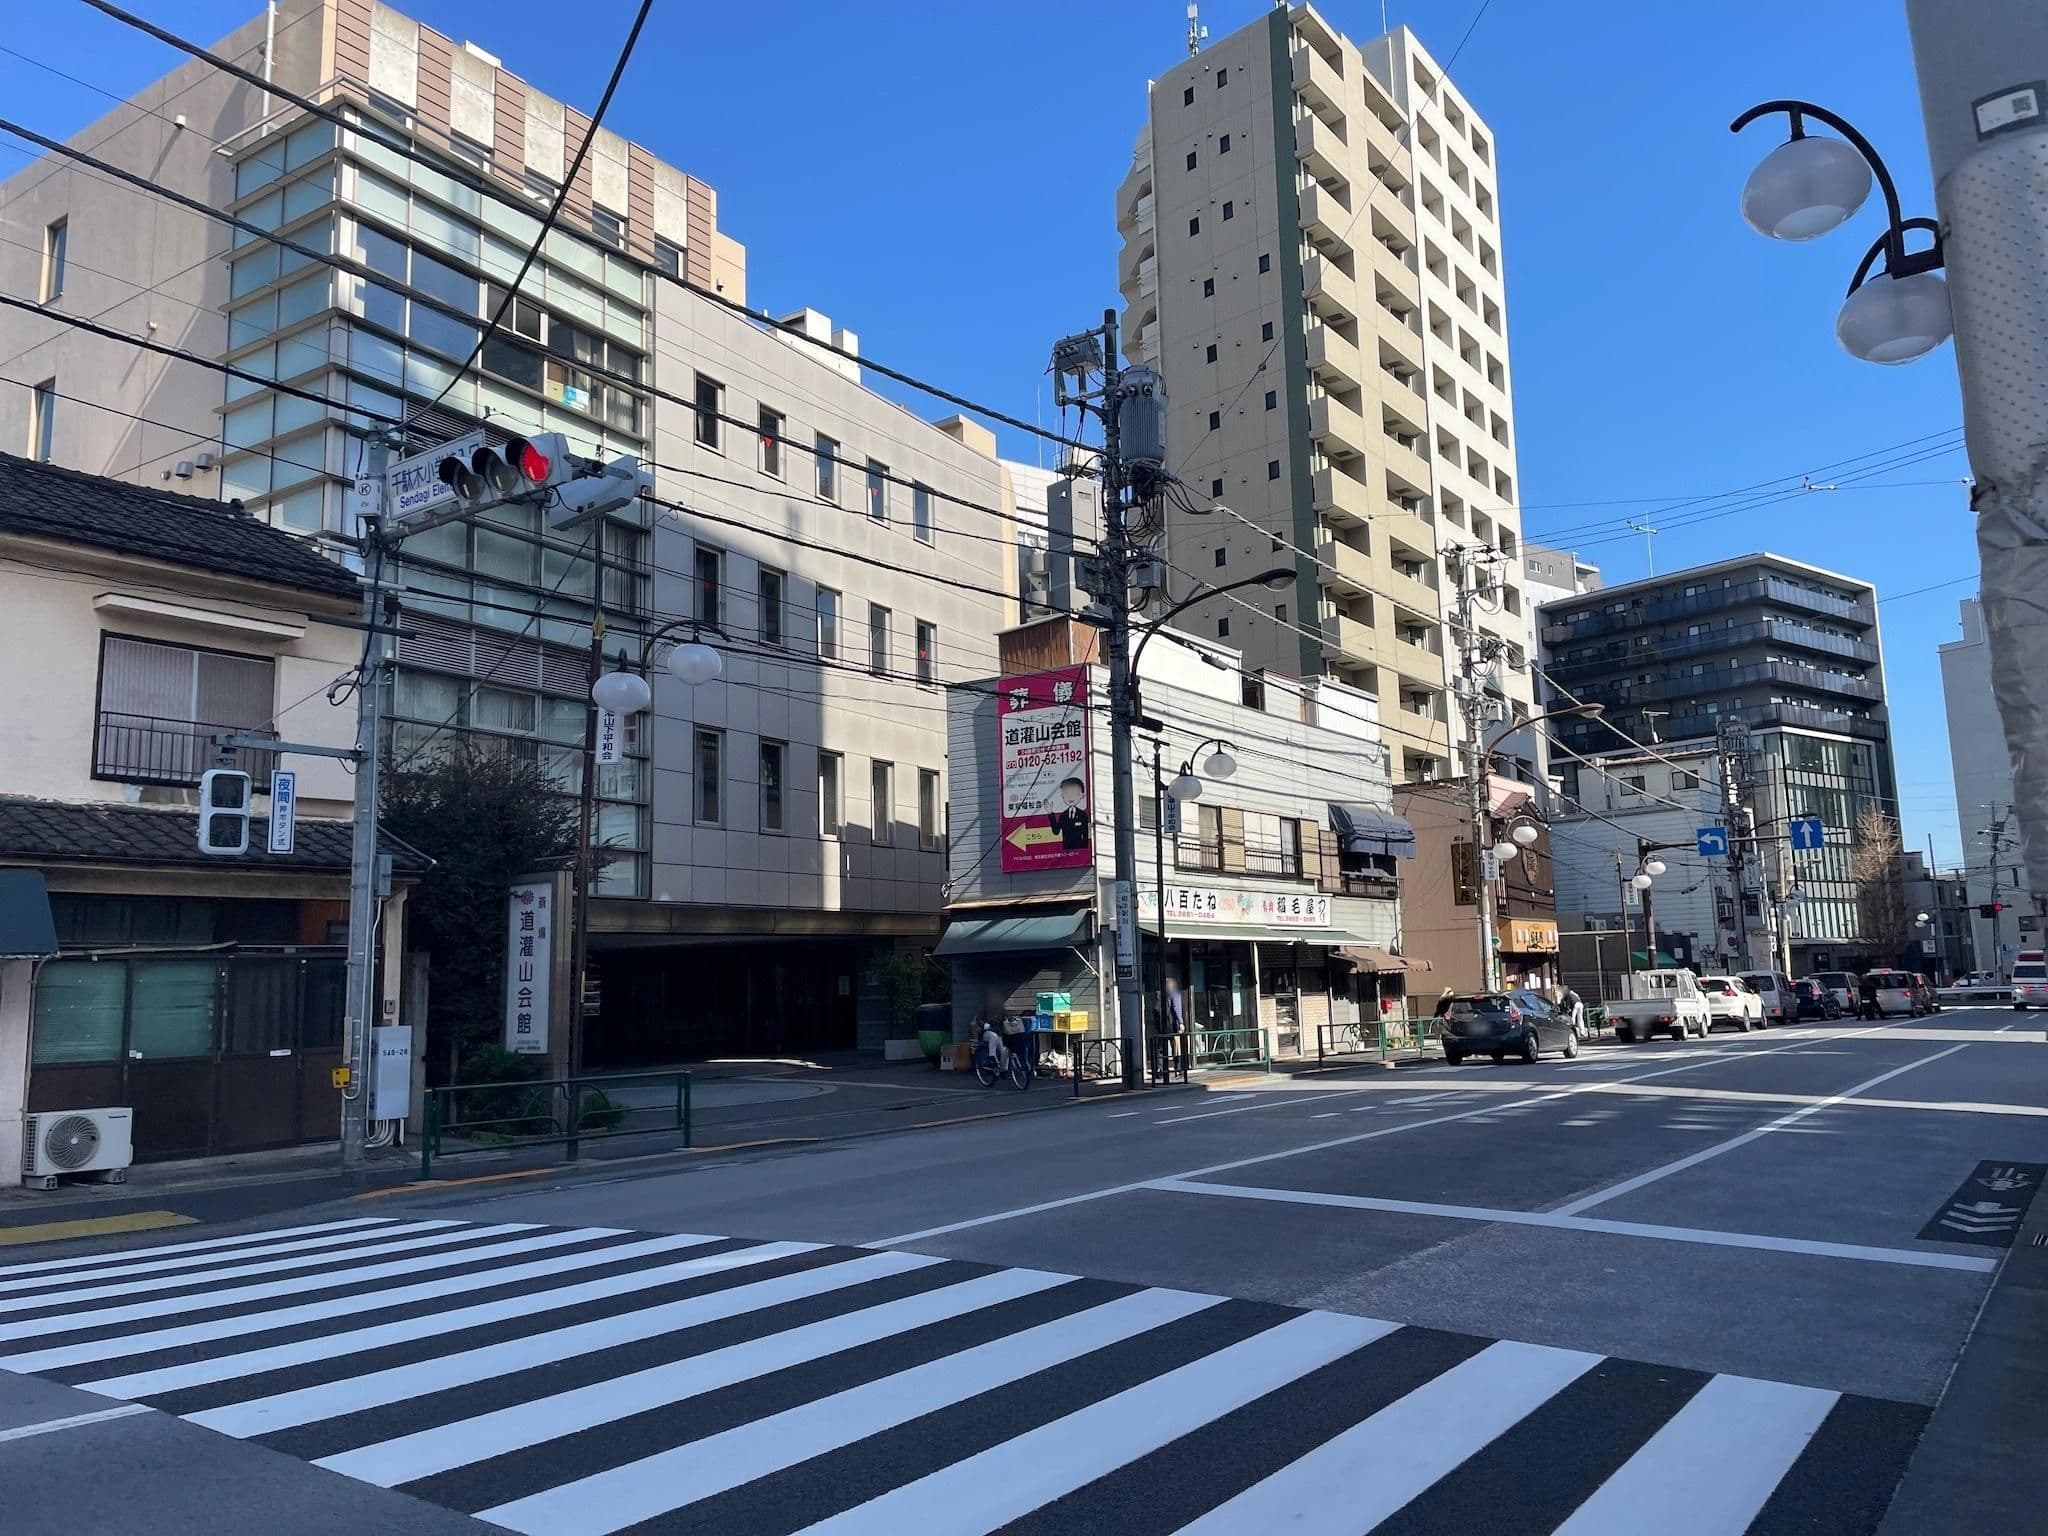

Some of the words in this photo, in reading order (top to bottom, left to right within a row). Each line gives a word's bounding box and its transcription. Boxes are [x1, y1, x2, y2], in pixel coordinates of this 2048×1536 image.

[400, 487, 431, 509] Sendagi
[433, 482, 451, 497] Elem
[1005, 719, 1082, 747] 道灌山会館
[1164, 888, 1217, 911] 八百たね
[516, 910, 535, 1034] 道灌山会館
